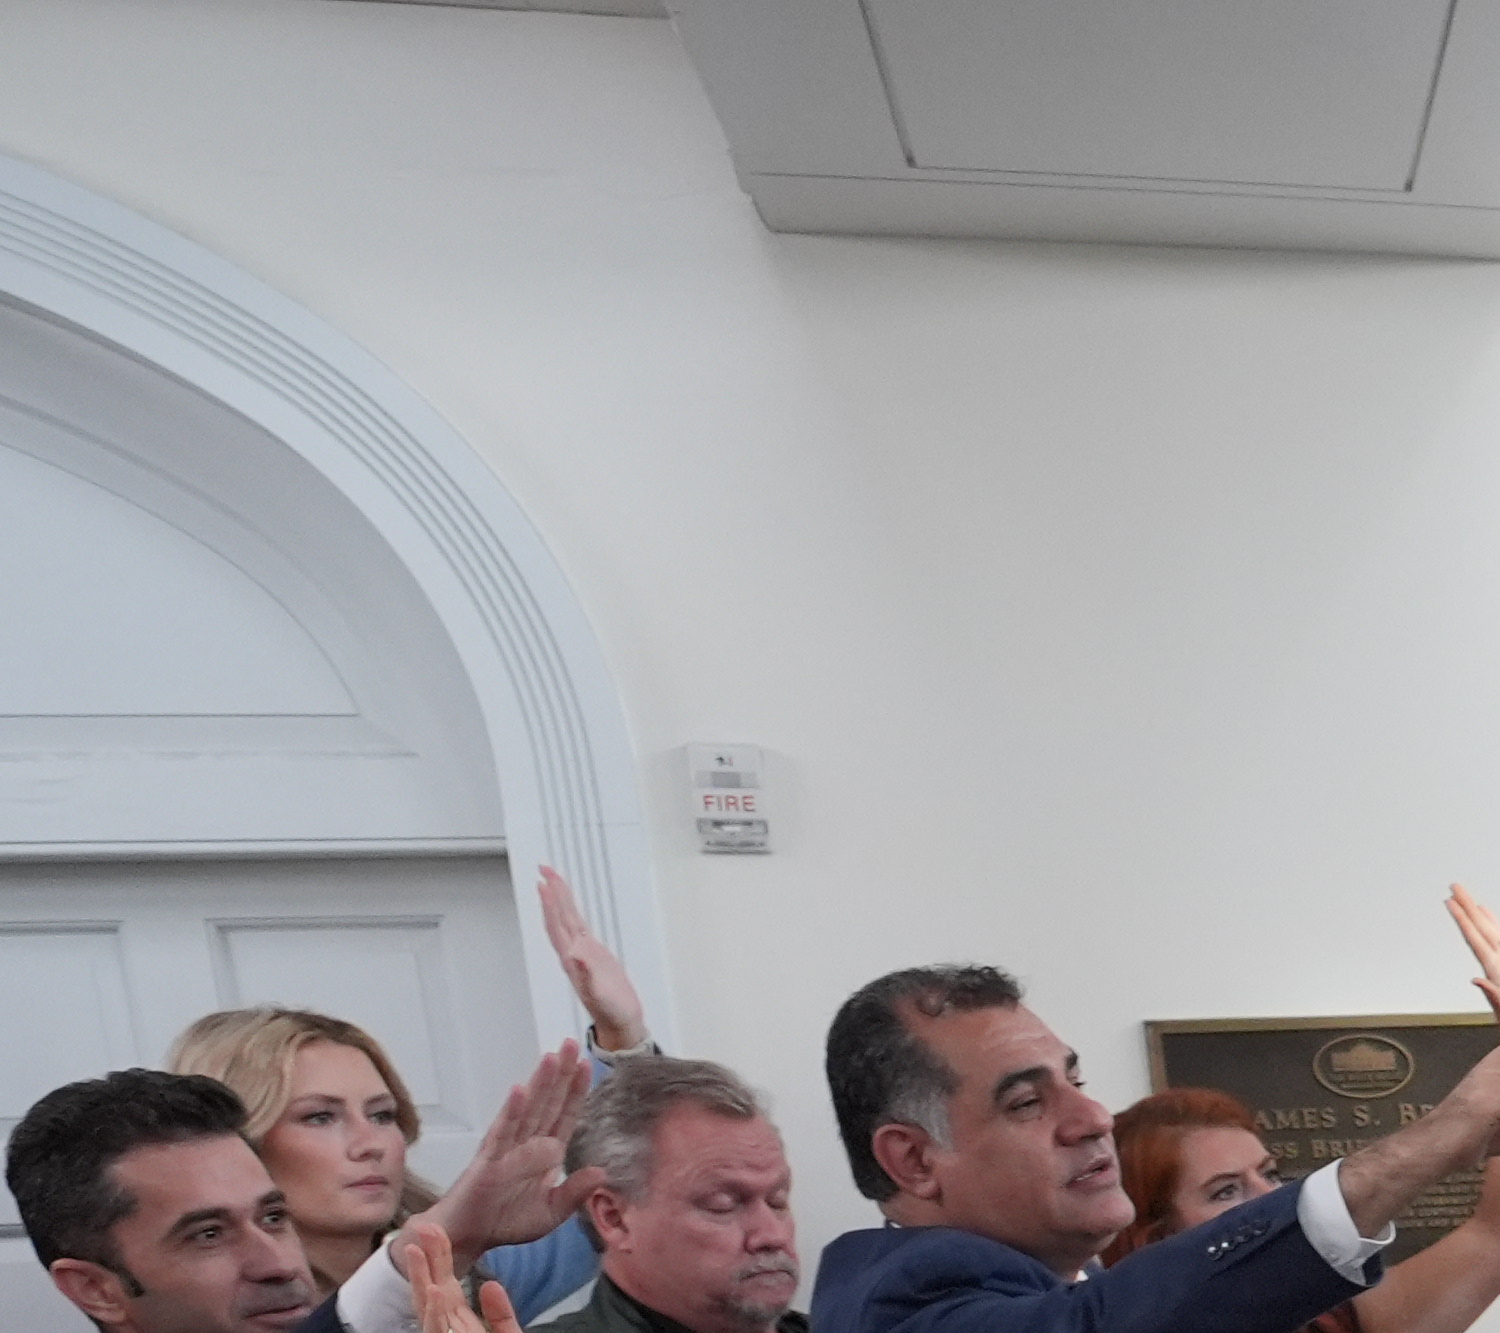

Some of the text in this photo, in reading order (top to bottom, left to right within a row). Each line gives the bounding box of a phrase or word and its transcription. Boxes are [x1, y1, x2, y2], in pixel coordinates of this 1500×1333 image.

[703, 795, 756, 812] FIRE
[1256, 1107, 1337, 1130] AMES
[1354, 1104, 1381, 1128] S.
